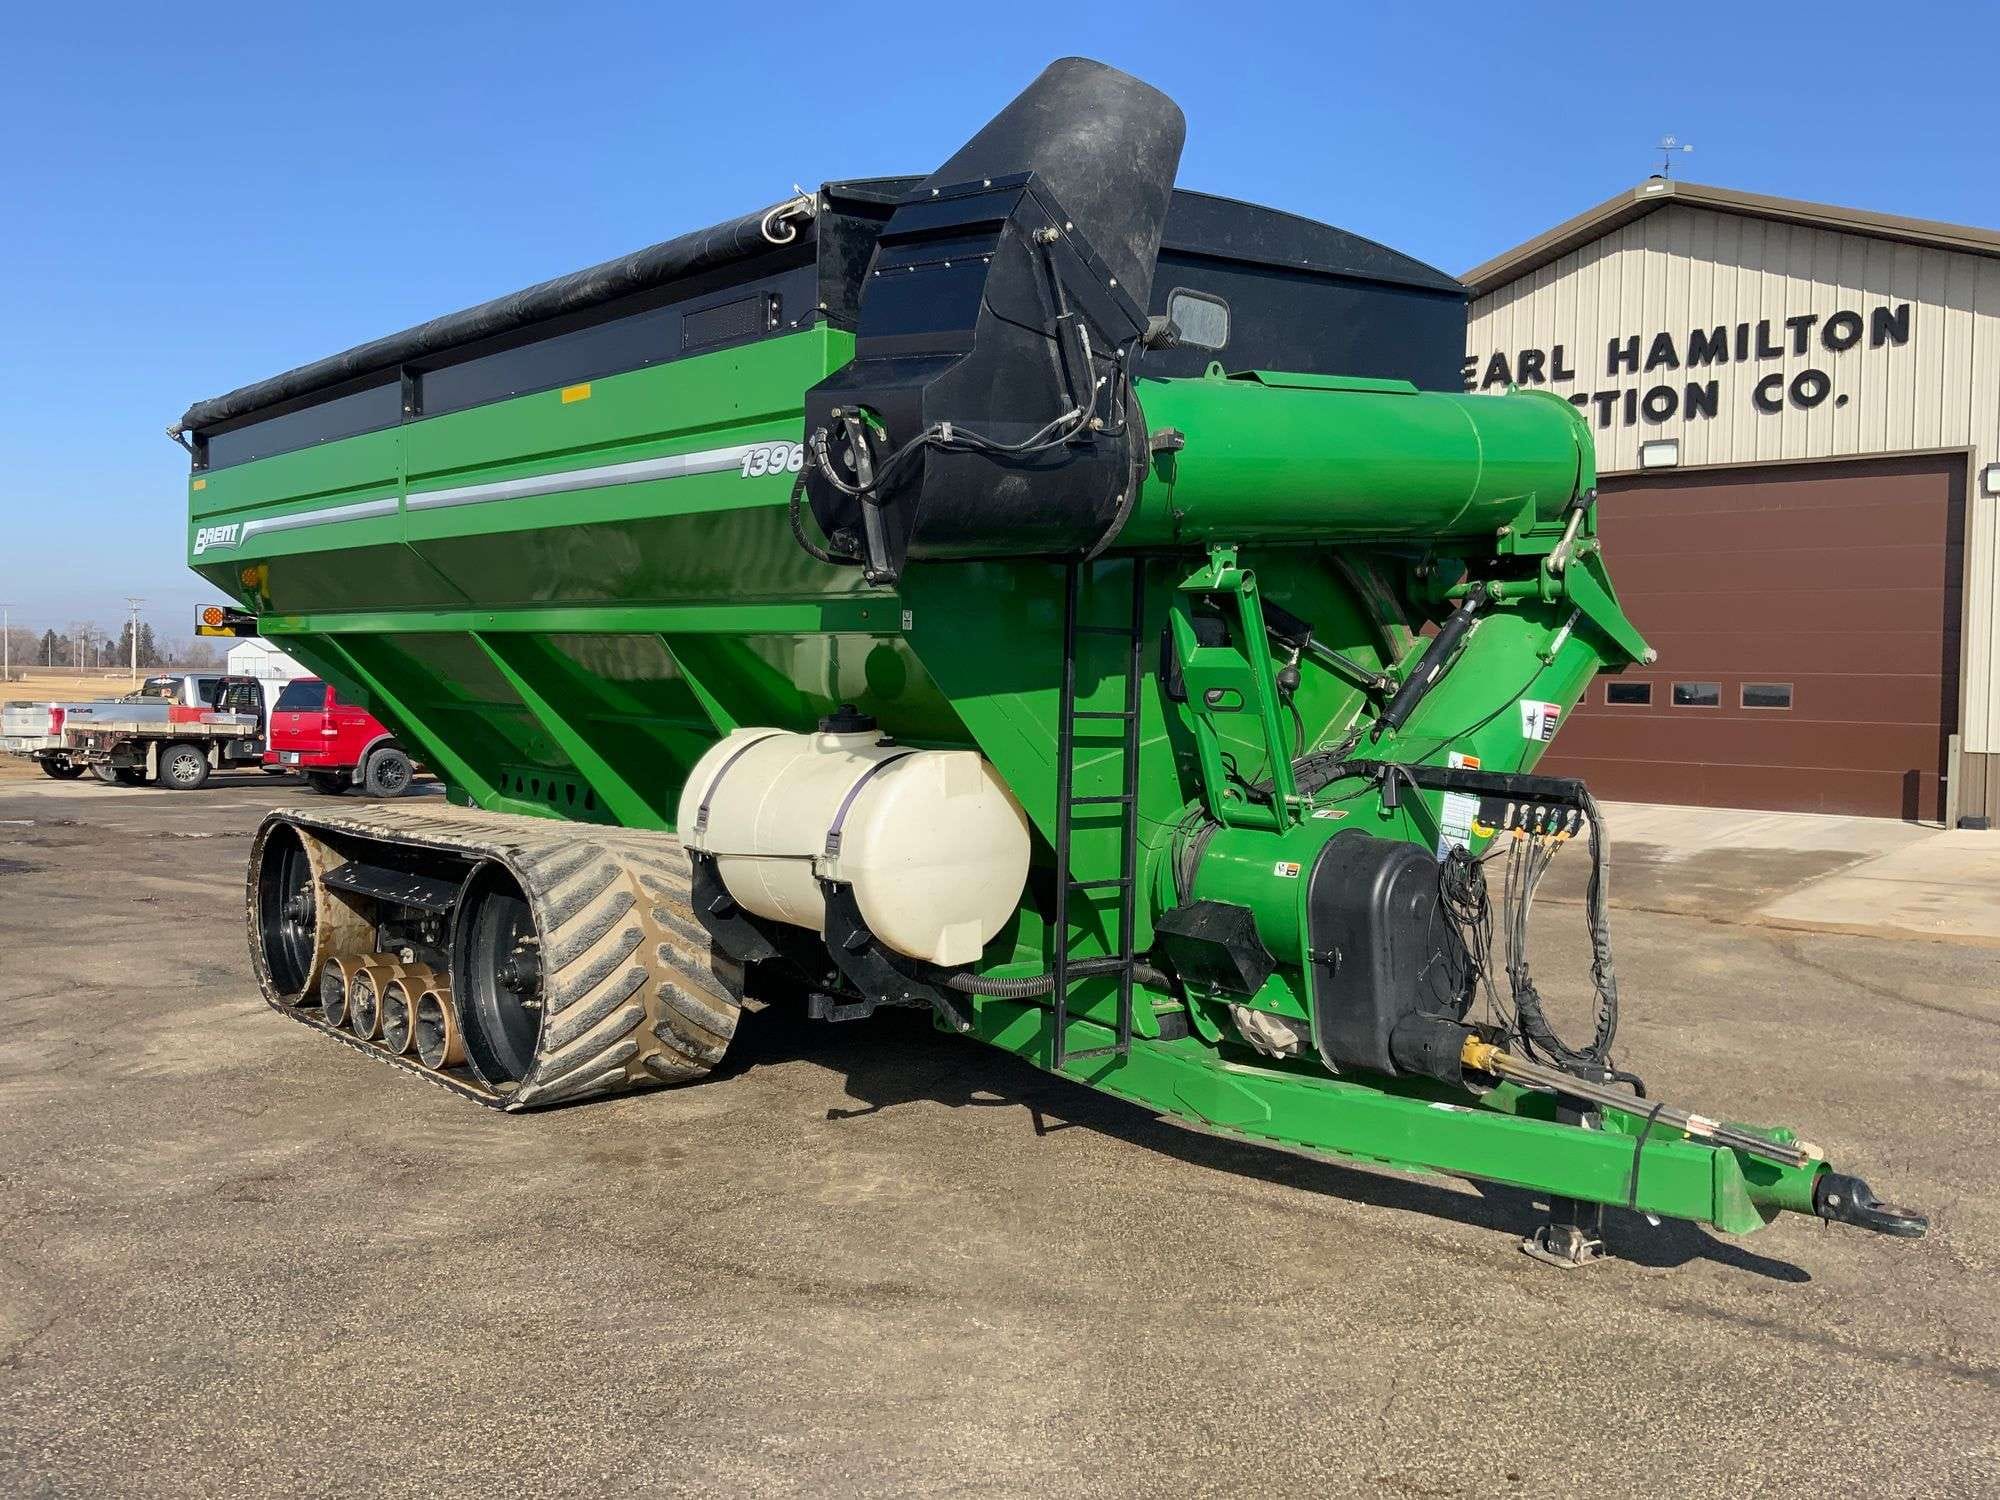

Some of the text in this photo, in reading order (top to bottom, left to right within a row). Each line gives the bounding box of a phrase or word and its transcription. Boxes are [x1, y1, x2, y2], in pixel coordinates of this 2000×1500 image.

[1463, 303, 1911, 391] EARL HAMILTON
[1752, 368, 1849, 414] CO.
[741, 444, 804, 478] 1396
[193, 523, 240, 555] BRENT
